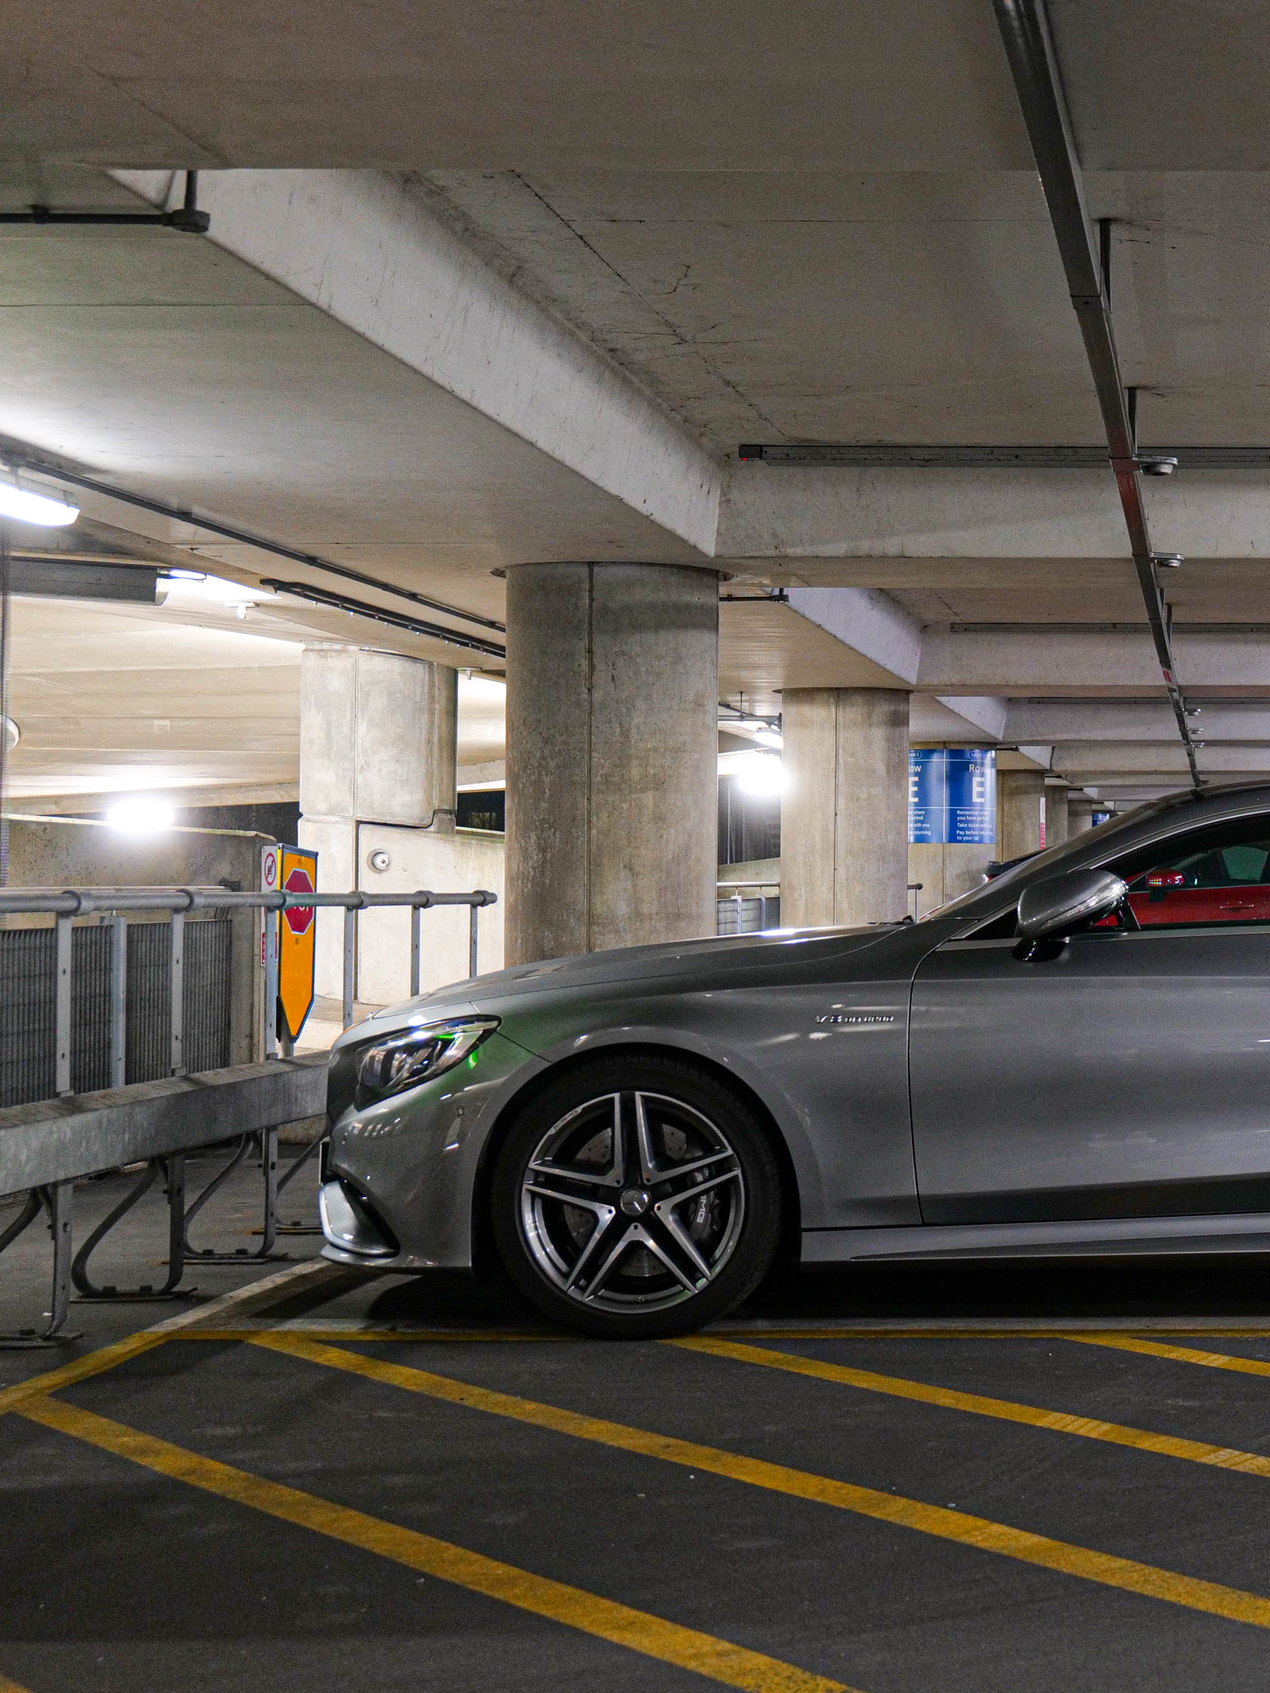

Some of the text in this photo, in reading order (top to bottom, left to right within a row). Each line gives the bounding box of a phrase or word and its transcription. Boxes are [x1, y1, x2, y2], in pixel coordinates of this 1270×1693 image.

[908, 764, 922, 773] ow
[969, 764, 987, 772] Row
[908, 776, 919, 802] E
[972, 776, 985, 803] E
